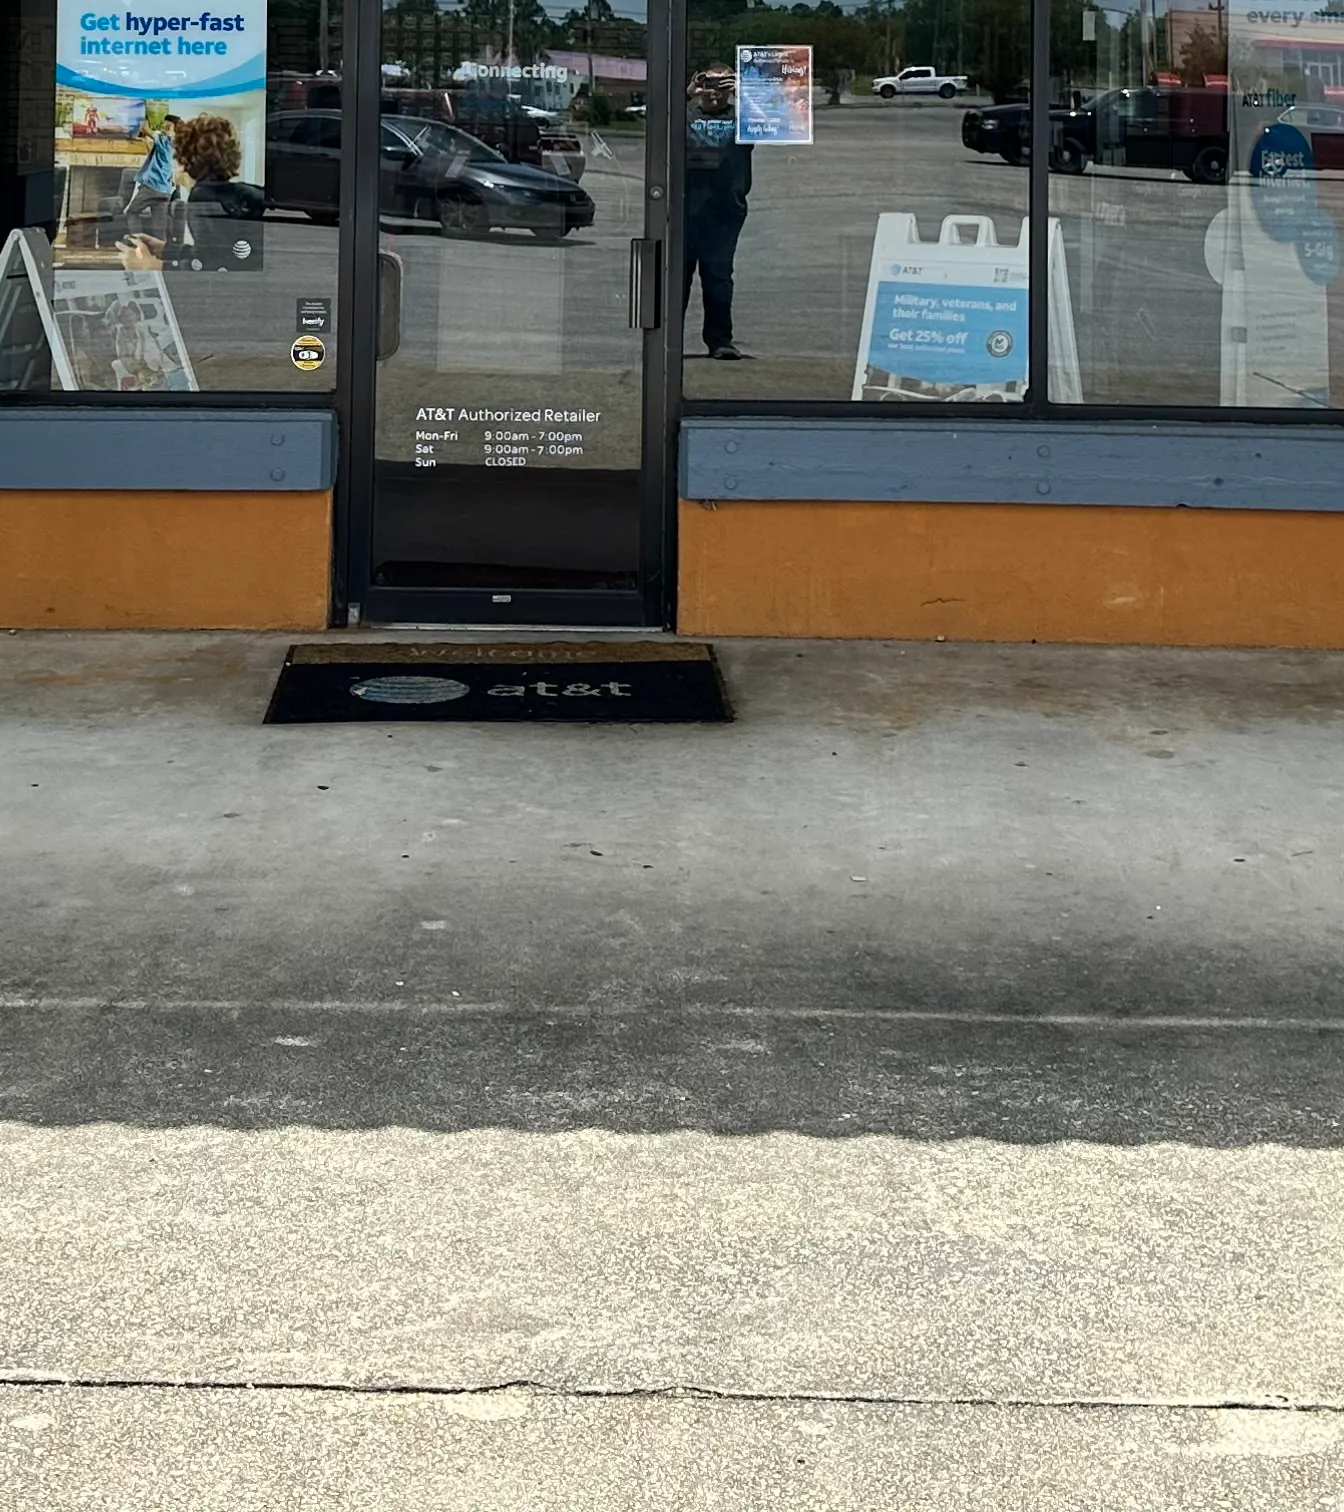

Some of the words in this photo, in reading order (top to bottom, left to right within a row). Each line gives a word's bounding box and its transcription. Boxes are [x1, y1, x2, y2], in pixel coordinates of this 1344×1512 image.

[80, 13, 121, 32] Get
[125, 12, 245, 35] hyper-fast
[1246, 10, 1305, 28] every
[80, 36, 172, 55] internet
[177, 36, 227, 55] here
[1266, 88, 1297, 107] fiber
[902, 266, 923, 275] AT&T
[893, 294, 939, 309] Military,
[942, 299, 994, 312] veterans,
[995, 301, 1017, 312] and
[892, 307, 920, 318] their
[921, 308, 966, 322] families
[888, 328, 915, 342] Get
[915, 330, 944, 344] 25%
[946, 332, 968, 345] off
[415, 407, 455, 421] AT&T
[458, 407, 541, 422] Authorized
[544, 408, 601, 422] Retailer
[415, 430, 459, 441] Mon-Fri
[484, 431, 529, 441] 9:00am
[538, 431, 583, 442] 7:00pm
[415, 444, 434, 454] Sat
[484, 444, 529, 455] 9:00am
[538, 445, 584, 456] 7:00pm
[414, 457, 437, 467] Sun
[484, 457, 527, 467] CLOSED
[486, 680, 633, 698] at&t
